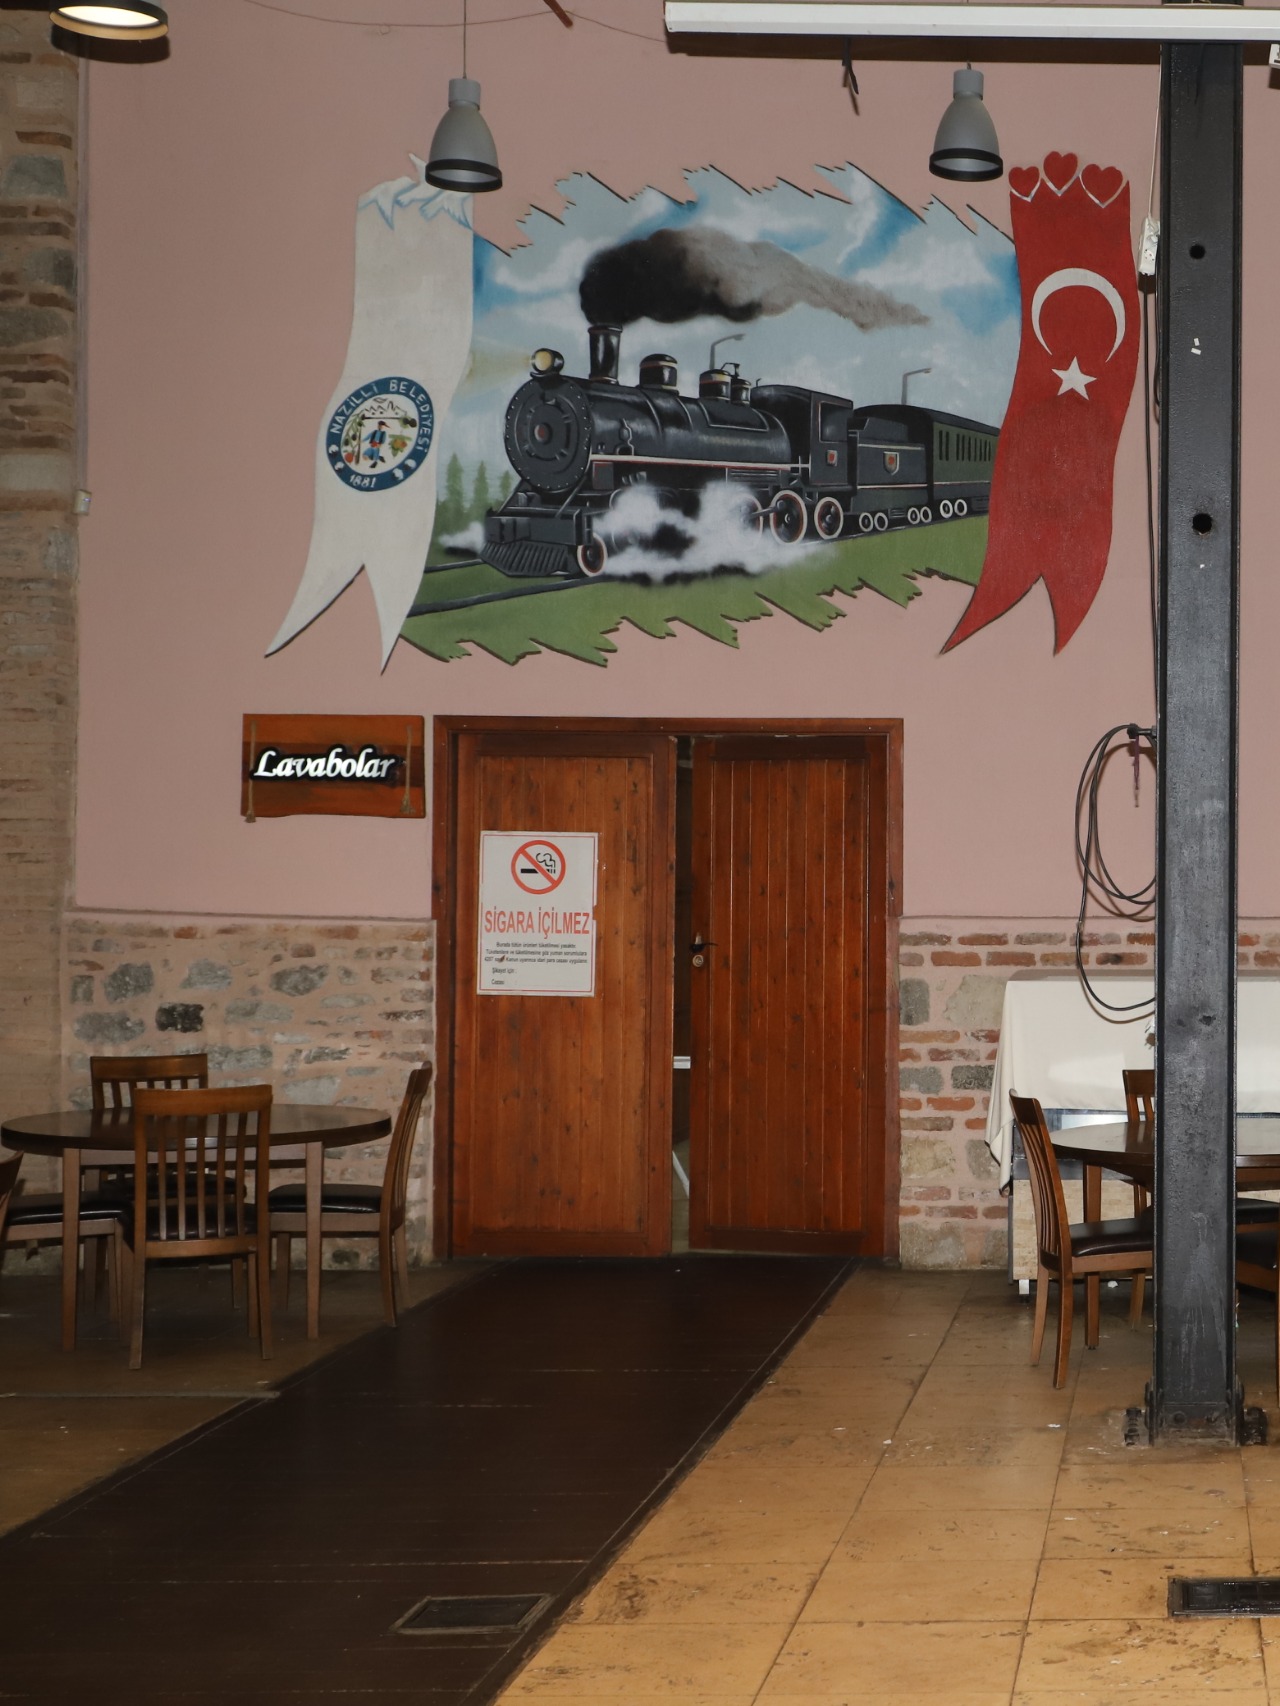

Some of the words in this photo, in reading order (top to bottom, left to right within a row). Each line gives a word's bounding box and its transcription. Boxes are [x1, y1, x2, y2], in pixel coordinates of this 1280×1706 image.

[349, 474, 377, 488] 1881
[254, 747, 396, 778] Lavabolar
[484, 906, 535, 934] SİGARA
[538, 907, 590, 940] İÇİLMEZ
